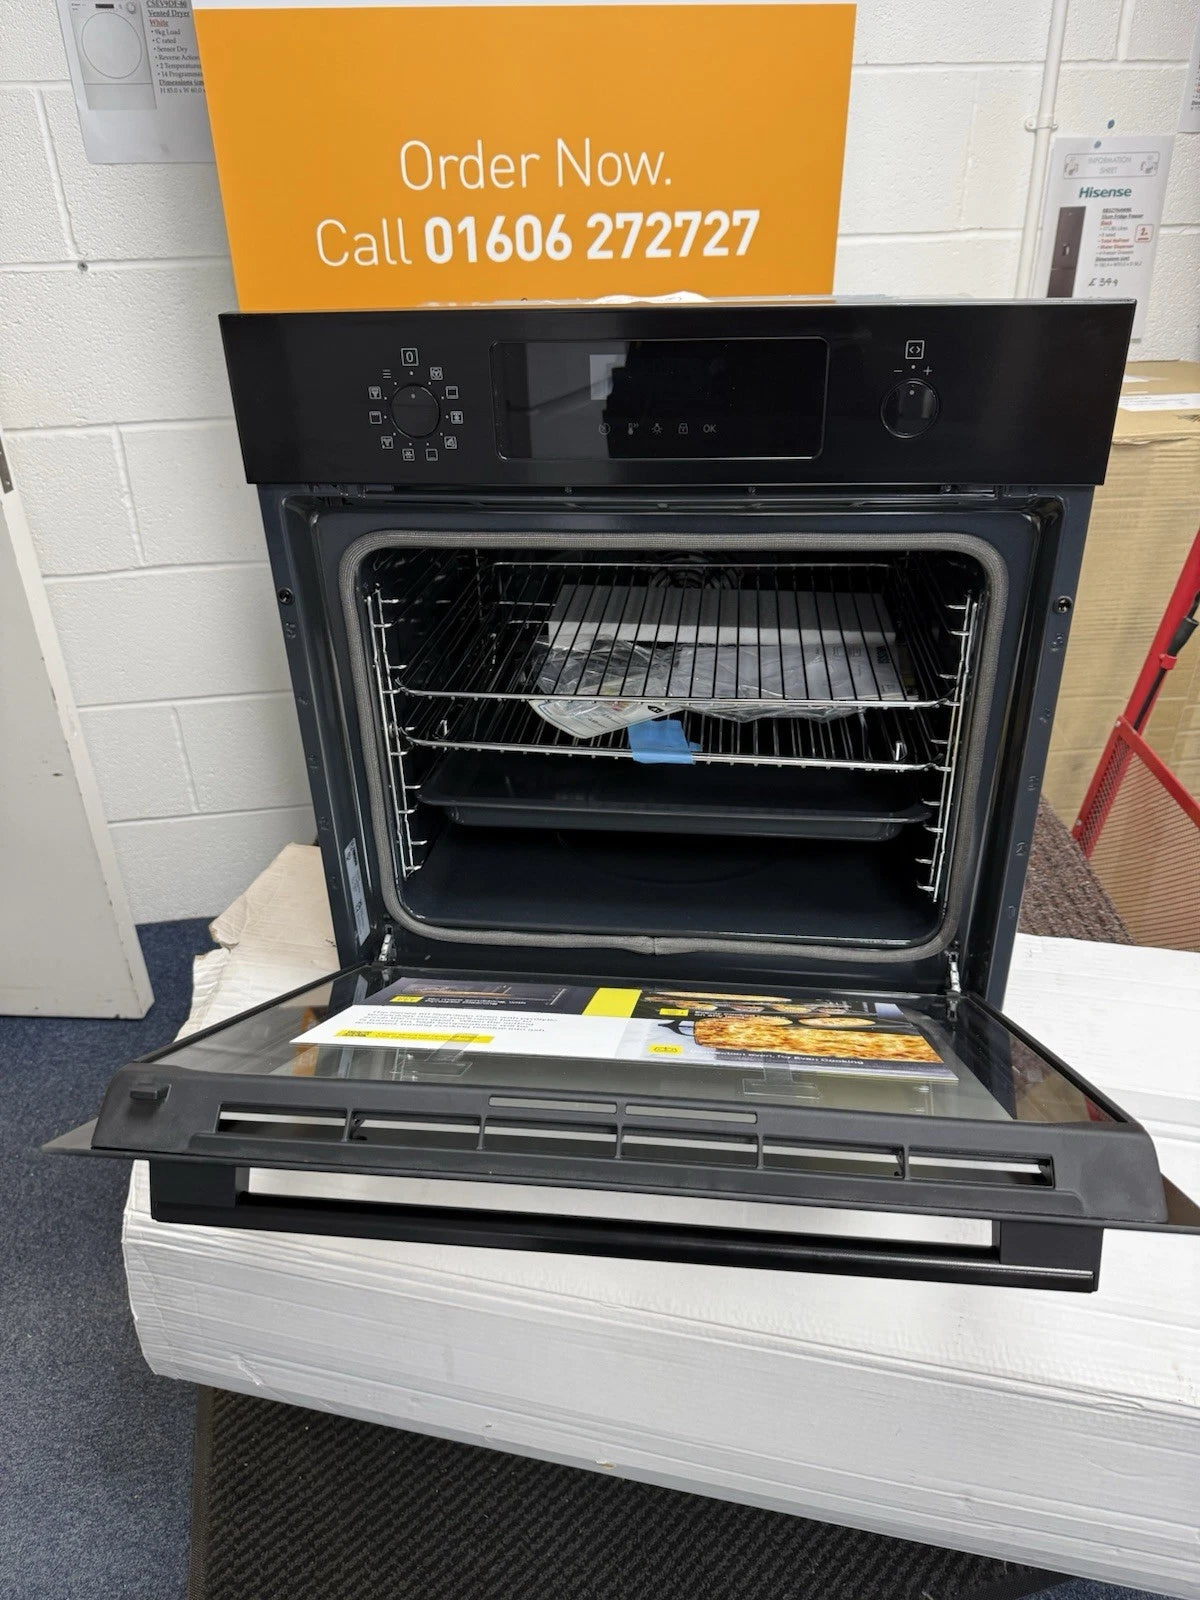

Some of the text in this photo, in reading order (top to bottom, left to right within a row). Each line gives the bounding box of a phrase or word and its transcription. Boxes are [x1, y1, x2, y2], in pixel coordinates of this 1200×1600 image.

[148, 9, 190, 18] Vented Dryer
[399, 137, 673, 191] Order Now.
[1079, 186, 1132, 199] Hisense
[316, 209, 761, 267] Call 01606 272727
[703, 424, 717, 434] OK
